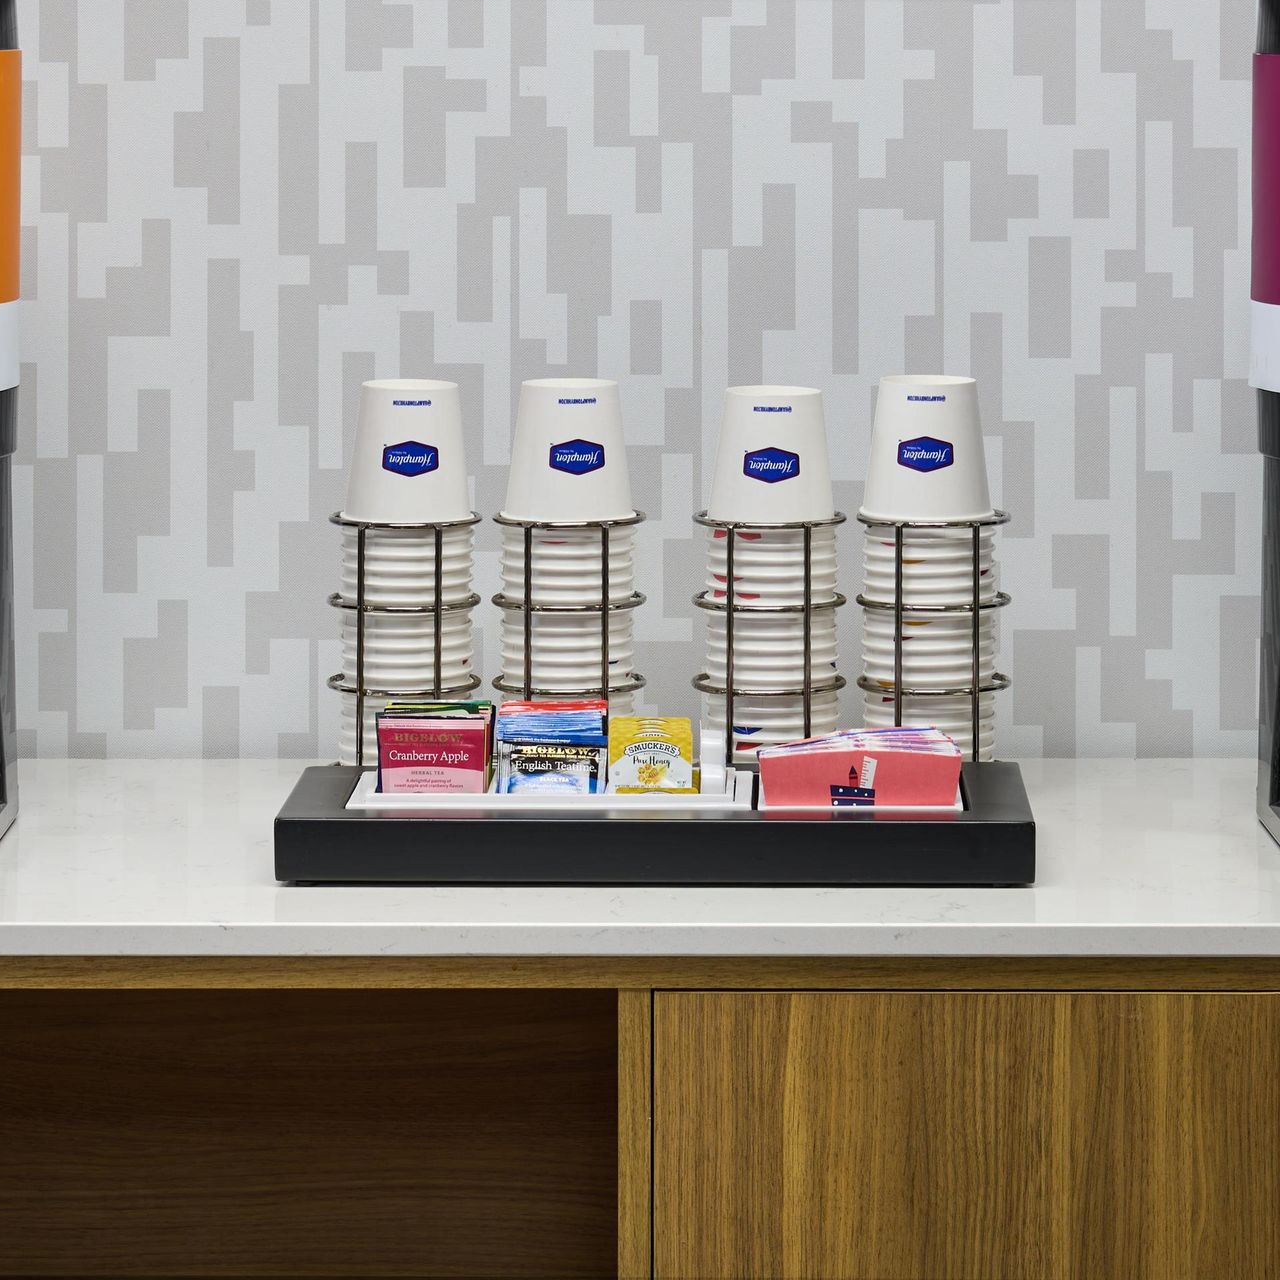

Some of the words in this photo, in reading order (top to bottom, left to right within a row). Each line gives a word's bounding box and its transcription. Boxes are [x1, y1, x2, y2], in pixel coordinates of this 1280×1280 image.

[388, 452, 435, 467] Hampton
[554, 450, 601, 465] Hampton
[902, 448, 950, 463] Hampton
[748, 458, 796, 474] Hampton
[627, 742, 677, 755] SMUCKER'S
[389, 750, 438, 764] Cranberry
[440, 750, 469, 764] Apple
[515, 761, 552, 772] English
